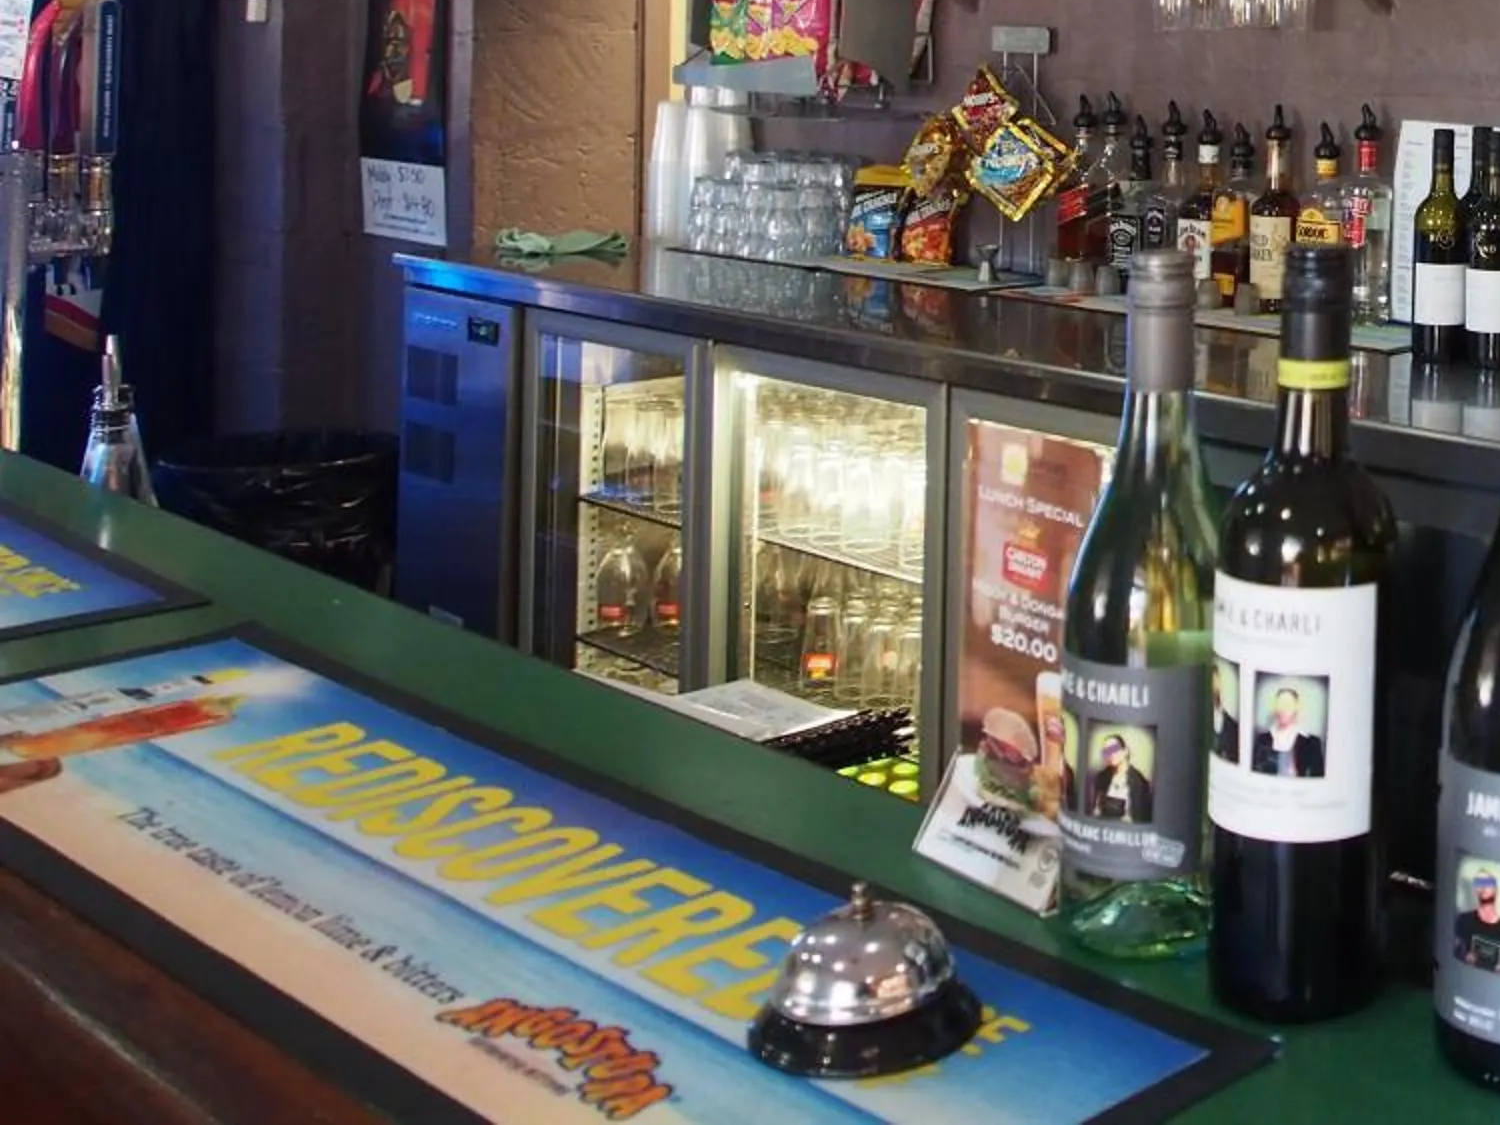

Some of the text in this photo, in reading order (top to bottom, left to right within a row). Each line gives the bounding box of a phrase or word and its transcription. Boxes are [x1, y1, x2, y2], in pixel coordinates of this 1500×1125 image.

[978, 484, 1083, 528] LUNCH SPECIAL
[991, 624, 1058, 663] $20.00
[1087, 680, 1150, 708] CHARLI
[382, 953, 466, 1006] bitters
